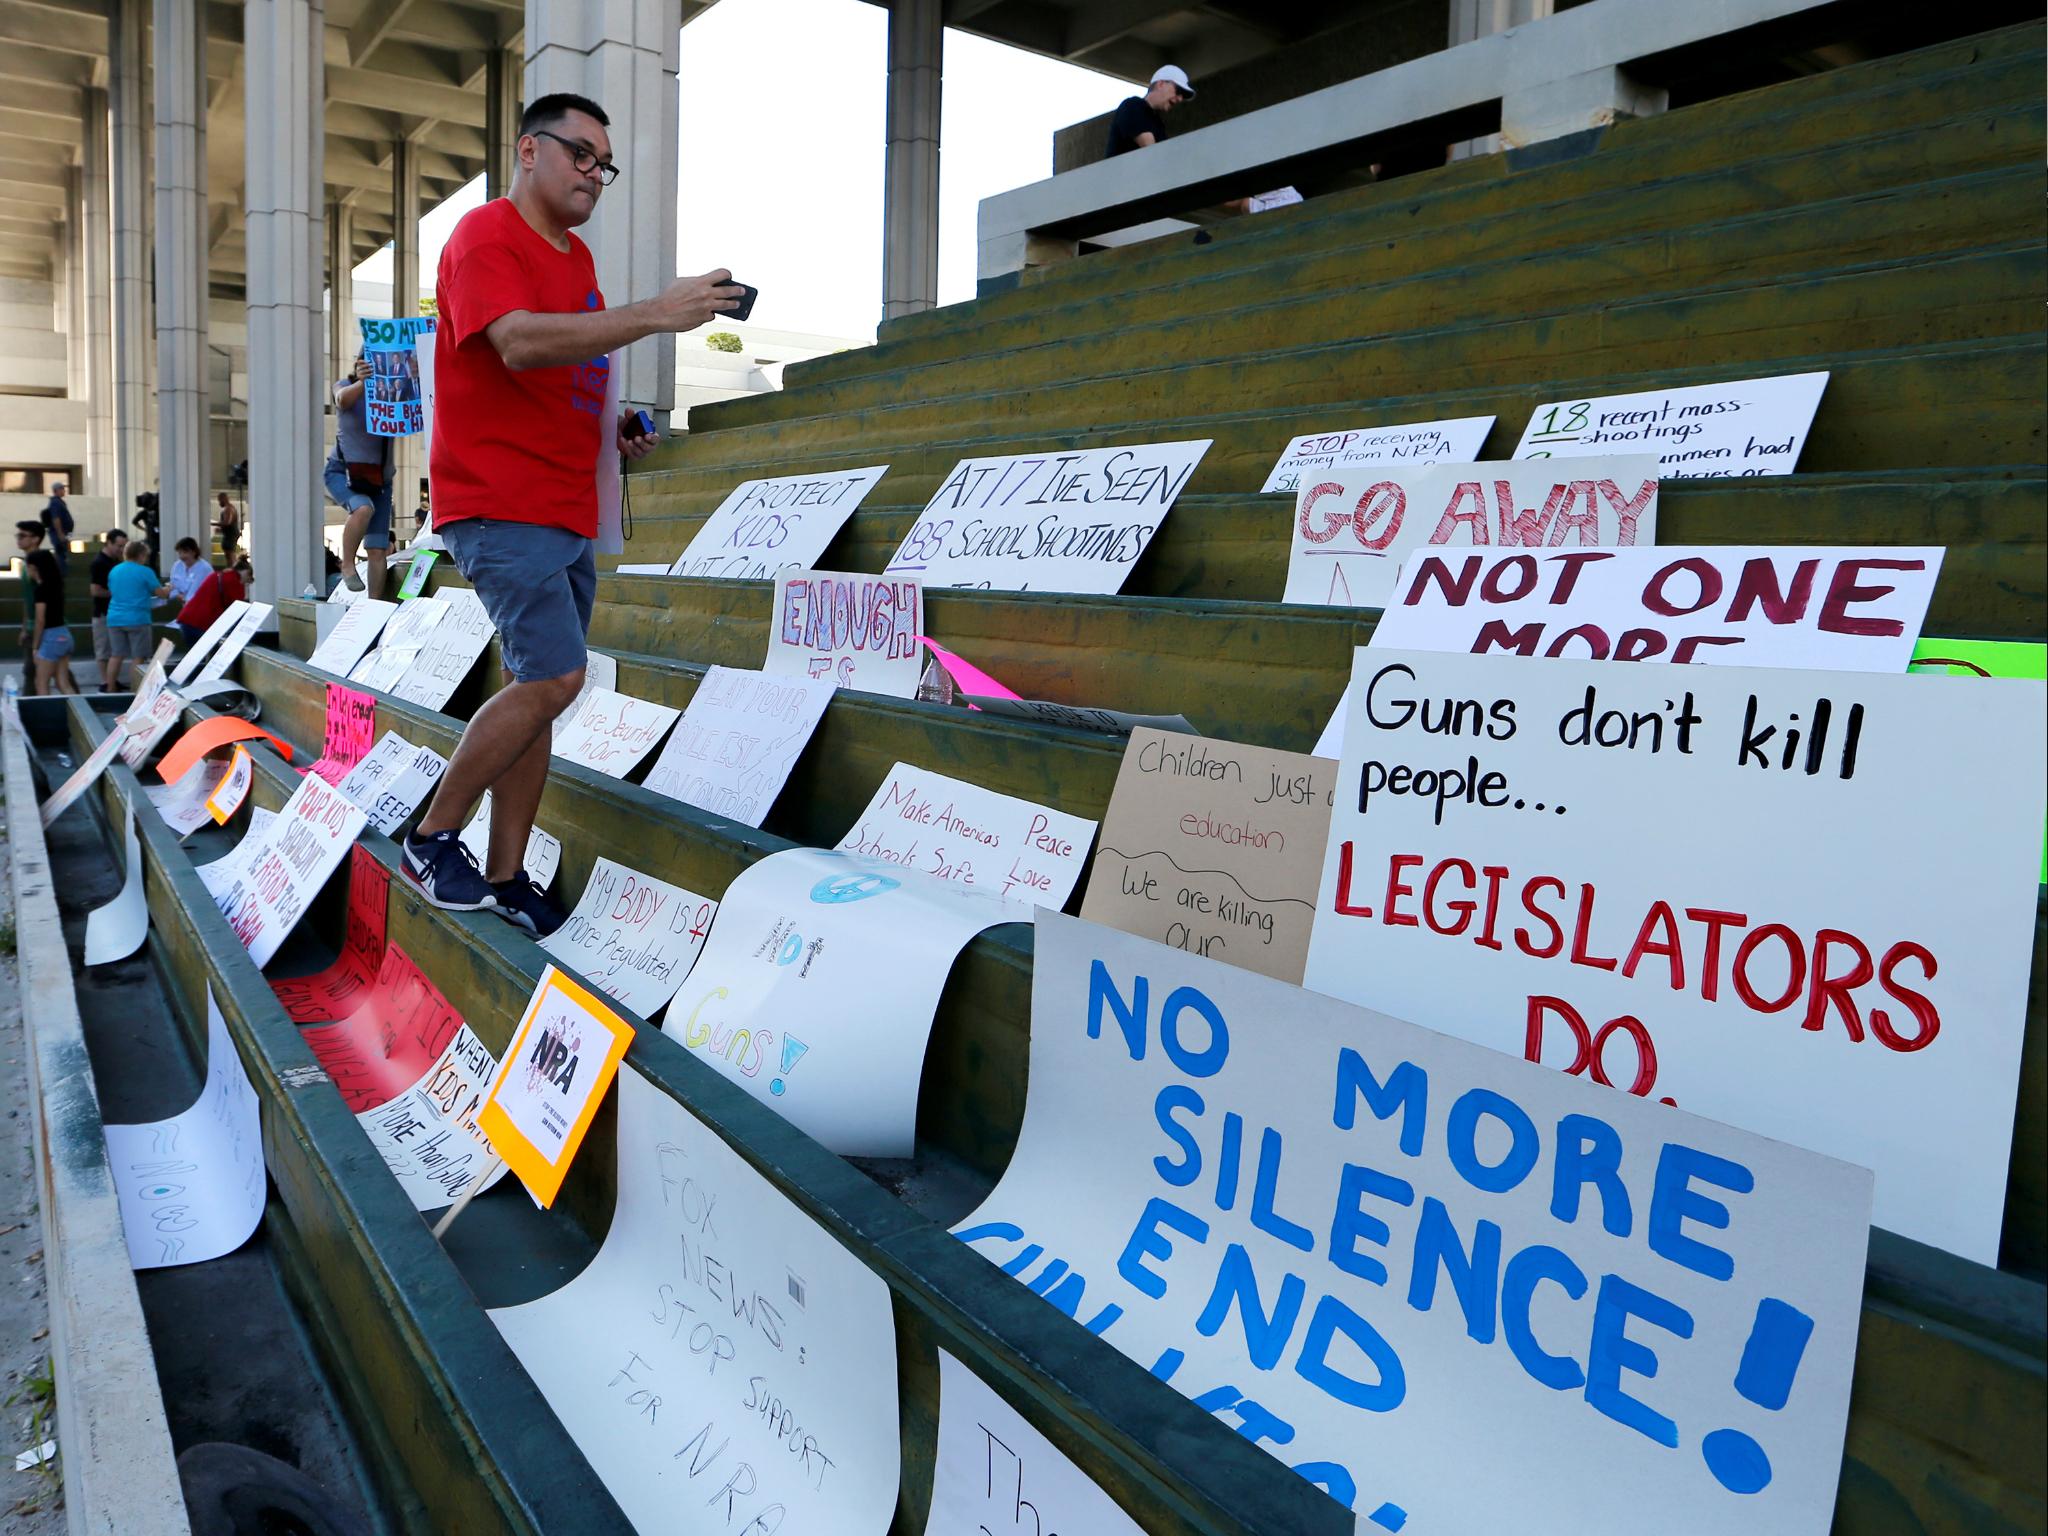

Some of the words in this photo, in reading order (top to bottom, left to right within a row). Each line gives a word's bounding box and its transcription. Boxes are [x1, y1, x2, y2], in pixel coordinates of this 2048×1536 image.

[369, 402, 395, 419] THE
[371, 416, 406, 434] YOUR
[1533, 401, 1591, 436] 18
[1599, 400, 1675, 427] recent
[1580, 422, 1703, 444] shootings
[1281, 455, 1335, 468] money
[1343, 449, 1381, 461] from
[1298, 433, 1359, 455] STOP
[1363, 431, 1442, 449] receiving
[1744, 436, 1795, 457] had
[731, 477, 866, 515] PROTECT
[926, 463, 997, 512] AT
[1084, 451, 1191, 505] SEEN
[722, 513, 802, 549] KIDS
[948, 519, 1029, 559] SCHOOL
[1017, 515, 1154, 563] SHOOTINGS
[1299, 480, 1406, 550] GO
[1428, 480, 1659, 547] AWAY
[781, 579, 918, 659] ENOUGH
[1404, 552, 1616, 606] NOT
[1642, 556, 1925, 637] ONE
[578, 695, 607, 732] More
[603, 701, 660, 753] Security
[588, 741, 620, 761] Our
[1366, 663, 1517, 741] Guns
[1559, 685, 1703, 754] don't
[1738, 693, 1865, 780] kill
[1138, 741, 1243, 783] Children
[1254, 763, 1316, 807] just
[295, 779, 333, 823] YOUR
[320, 798, 355, 839] KIDS
[878, 781, 931, 826] Make
[931, 803, 1001, 848] Americas
[1023, 814, 1073, 857] Peace
[1179, 811, 1285, 852] education
[919, 848, 975, 885] Safe
[1008, 856, 1052, 891] Love
[586, 866, 617, 919] My
[611, 876, 668, 933] BODY
[668, 902, 691, 934] IS
[1122, 865, 1160, 901] We
[1177, 888, 1212, 914] are
[1218, 895, 1274, 945] killing
[596, 930, 679, 985] Regulated
[1334, 841, 1941, 1053] LEGISLATORS
[422, 1053, 468, 1114] KIDS
[455, 1028, 490, 1079] WHEN
[529, 1028, 580, 1096] NRA
[1086, 957, 1230, 1079] NO
[1334, 1046, 1755, 1282] MORE
[656, 1142, 718, 1240] FOX
[1117, 1197, 1407, 1413] END
[1153, 1084, 1817, 1496] SILENCE!
[651, 1284, 736, 1376] STOP
[608, 1350, 663, 1426] FOR
[977, 1422, 1058, 1536] Th
